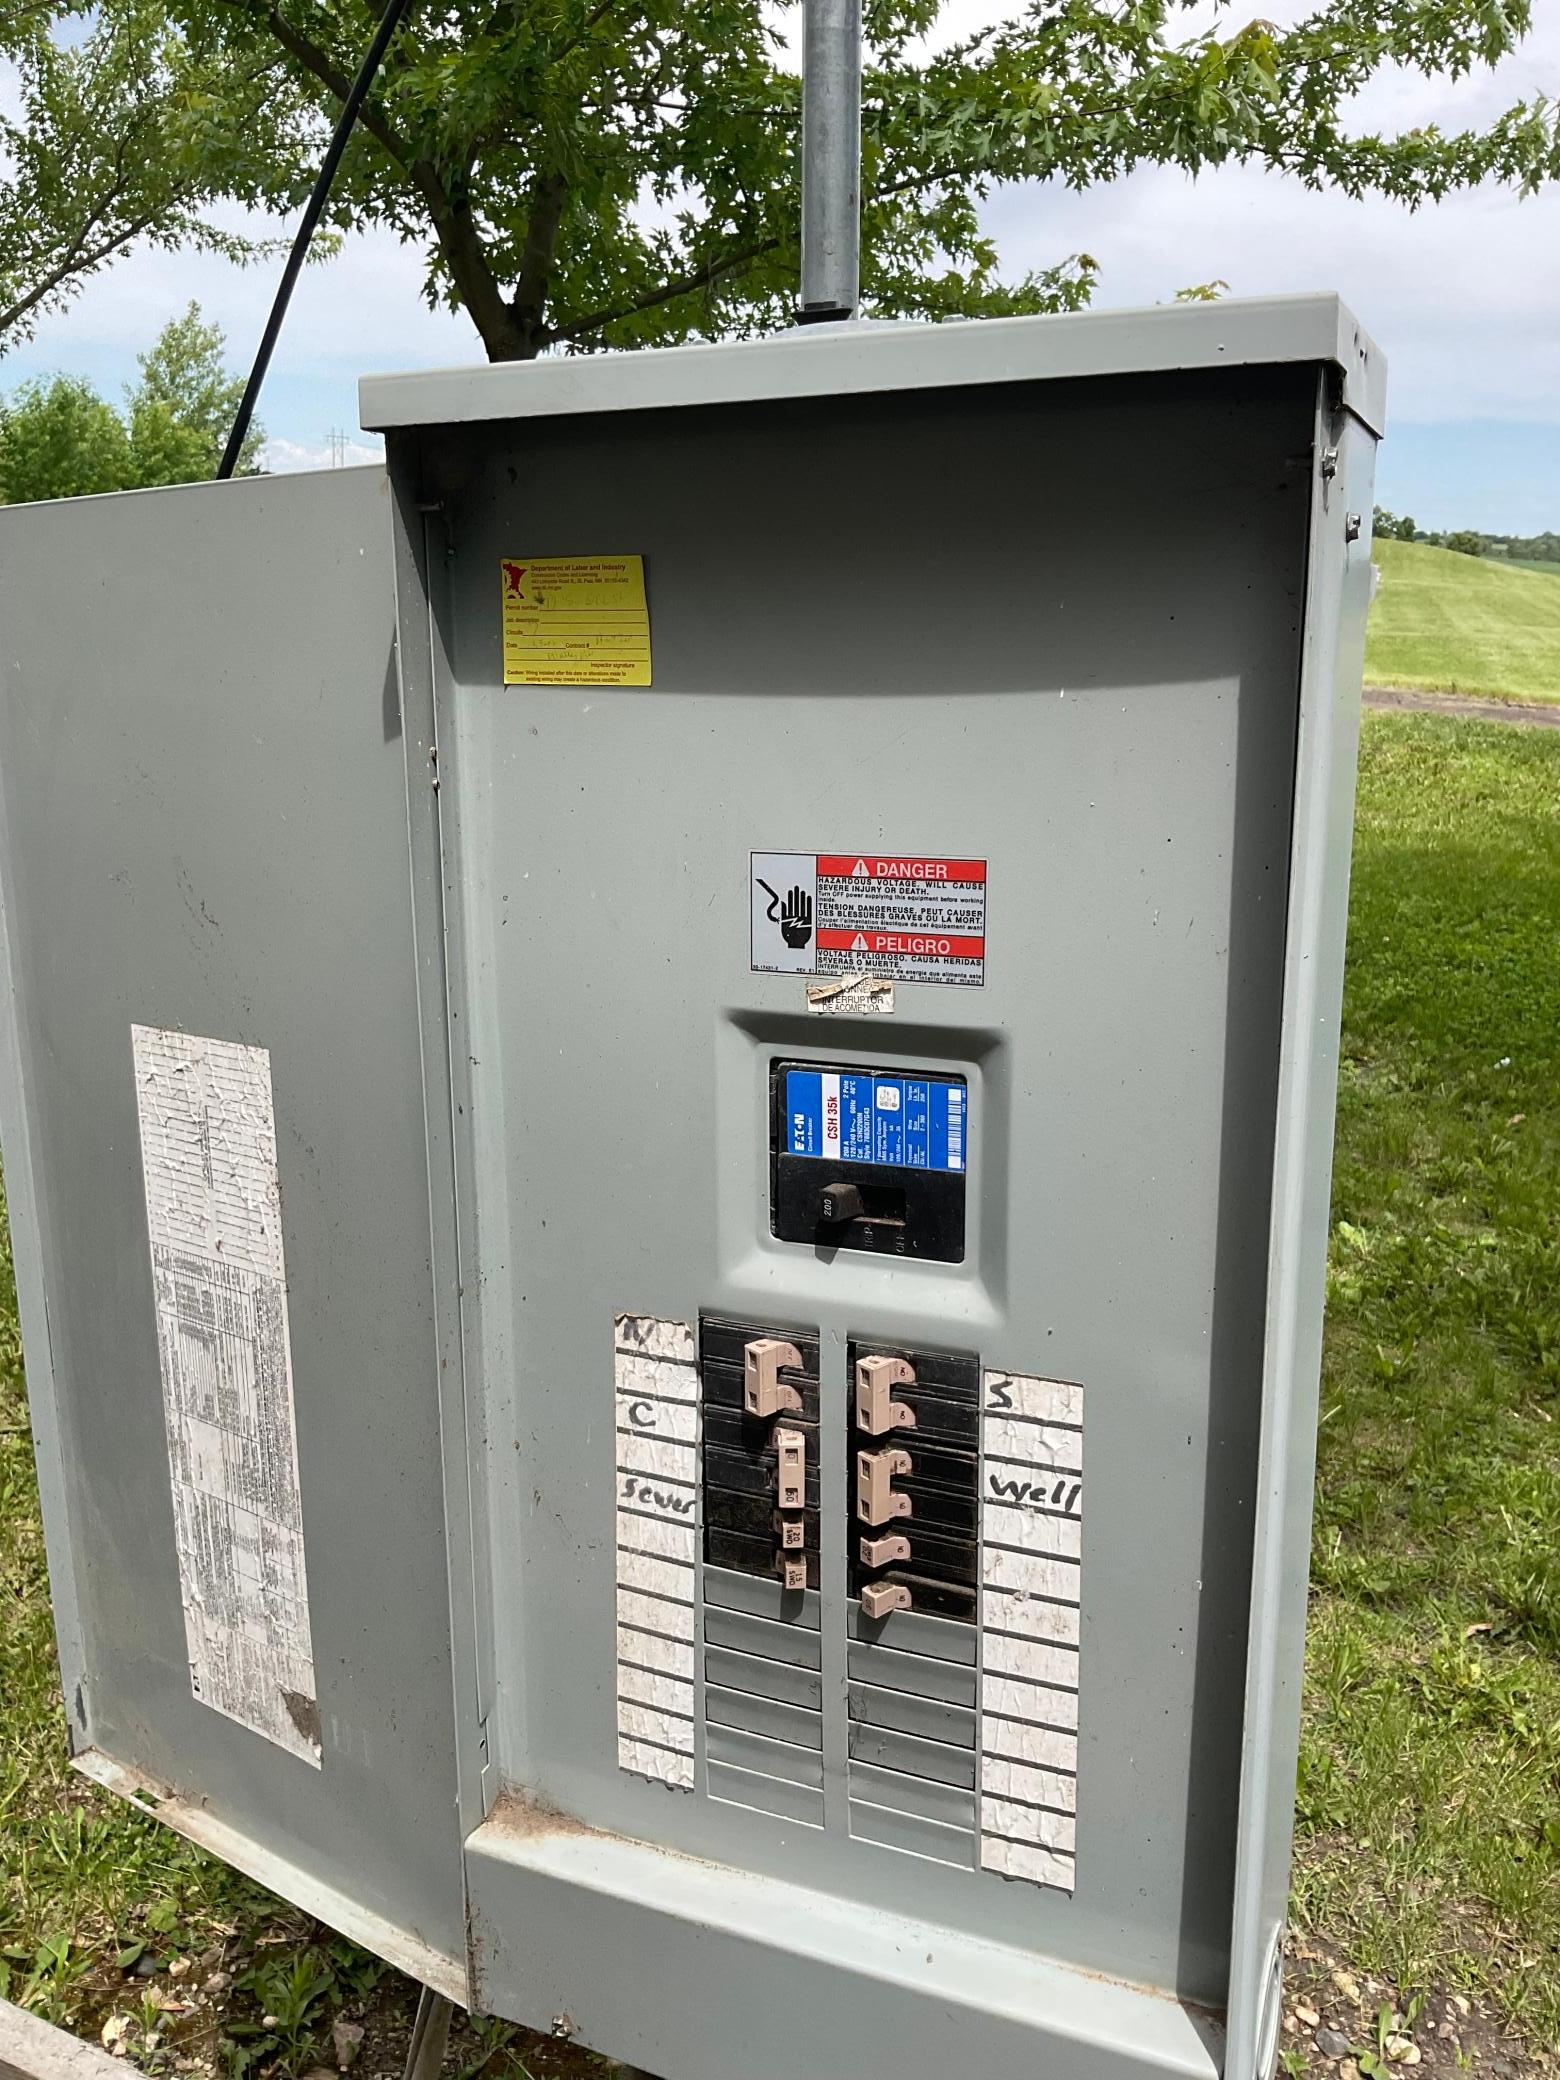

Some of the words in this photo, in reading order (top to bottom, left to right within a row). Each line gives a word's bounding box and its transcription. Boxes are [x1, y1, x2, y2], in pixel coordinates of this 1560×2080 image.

[602, 564, 626, 572] Industry
[877, 862, 947, 878] DANGER
[818, 876, 872, 885] HAZARDOUS
[818, 884, 849, 892] SEVERE
[818, 903, 854, 911] TENSION
[858, 905, 917, 914] DANGEREUSE.
[947, 909, 983, 917] CAUSER
[838, 911, 885, 919] BLESSURES
[889, 913, 922, 921] GRAVES
[876, 936, 950, 954] PELIGRO
[818, 950, 852, 958] VOLTAJE
[857, 952, 907, 962] PELIGROSO.
[944, 958, 981, 966] HERIDAS
[818, 957, 854, 965] SEVERAS
[824, 996, 884, 1004] INTERRUPTOR
[827, 1096, 837, 1114] 35k
[794, 1114, 804, 1150] EATON
[827, 1118, 838, 1139] CSH
[824, 1199, 832, 1216] 200
[864, 1226, 873, 1248] TRIP
[629, 1401, 656, 1427] C
[794, 1532, 800, 1542] 20
[788, 1571, 796, 1586] SWD
[795, 1573, 802, 1582] 15
